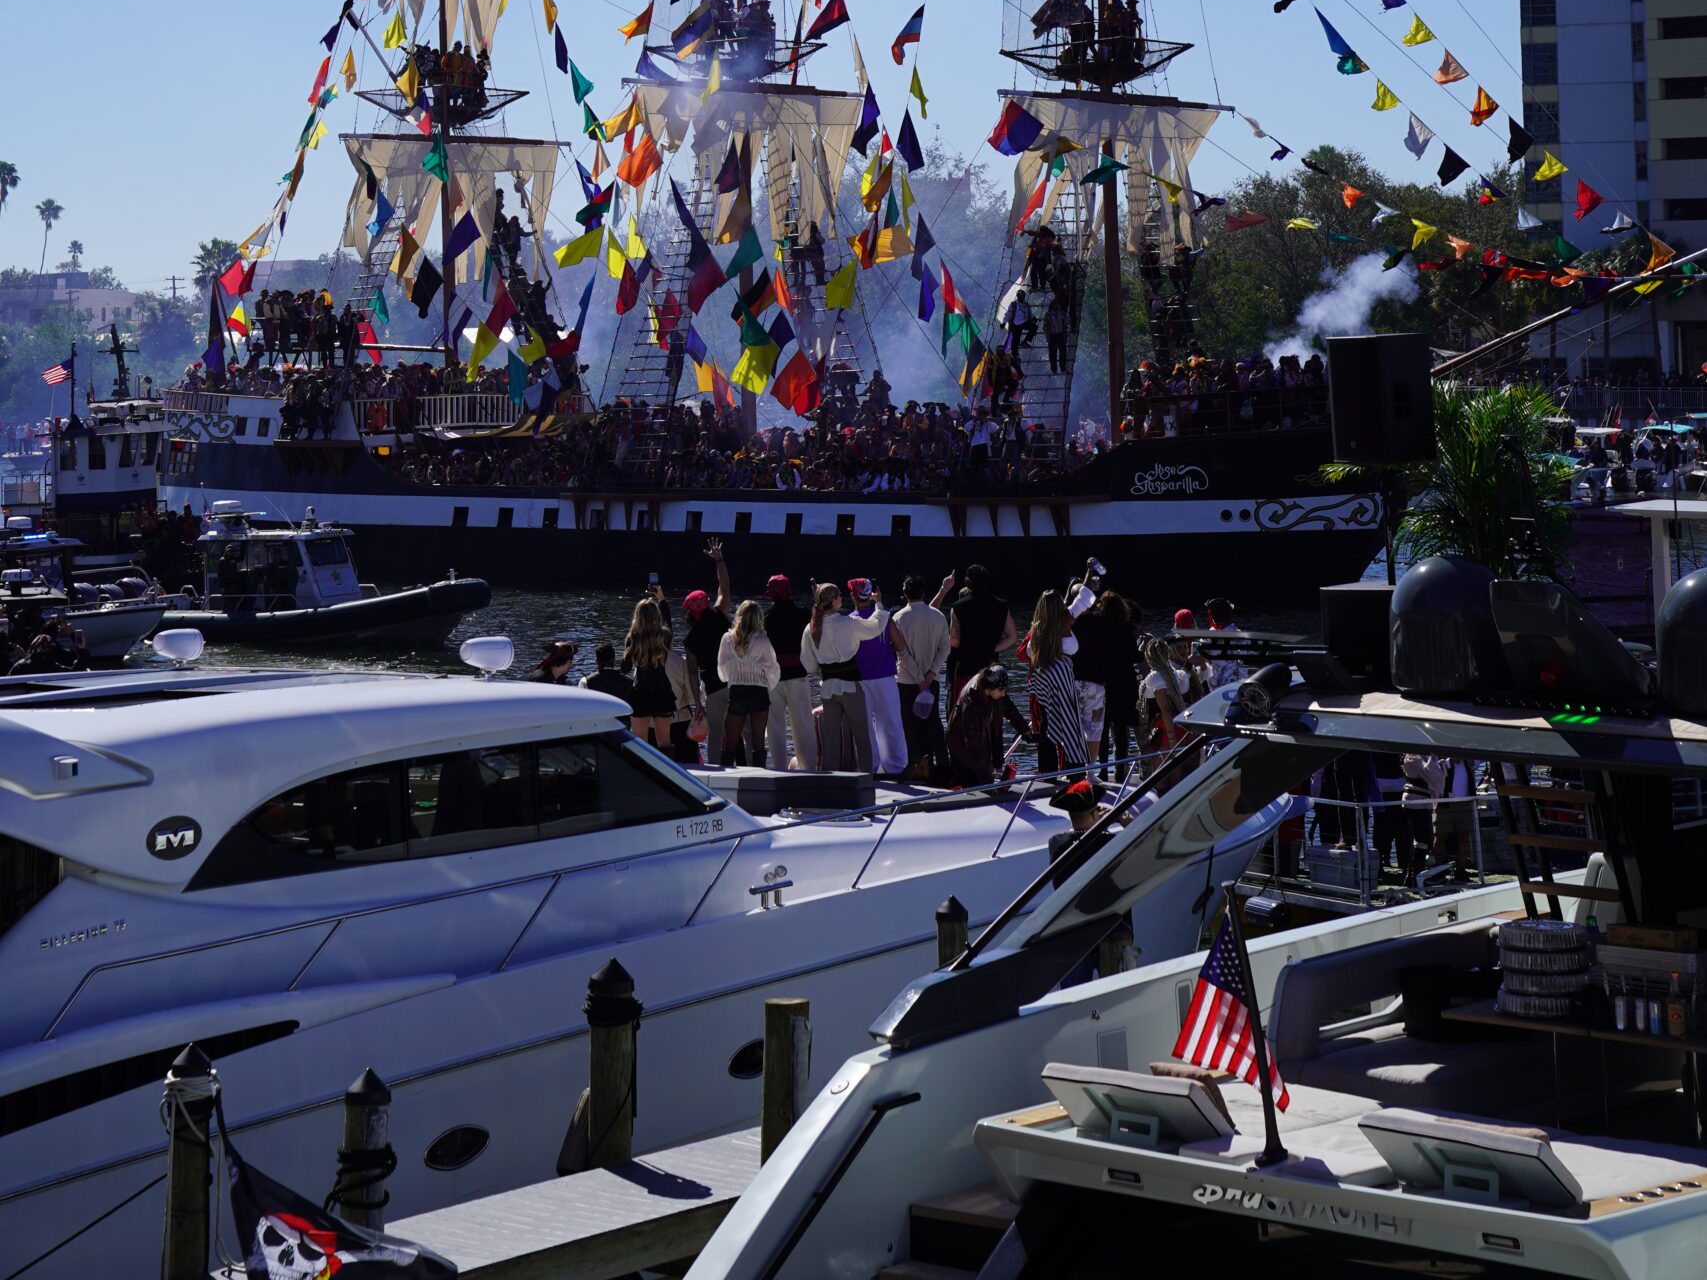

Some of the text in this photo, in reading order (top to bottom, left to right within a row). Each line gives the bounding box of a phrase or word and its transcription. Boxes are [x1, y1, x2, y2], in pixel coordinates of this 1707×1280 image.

[1130, 470, 1207, 495] Gasparilla
[676, 819, 723, 838] FL 1722 RB
